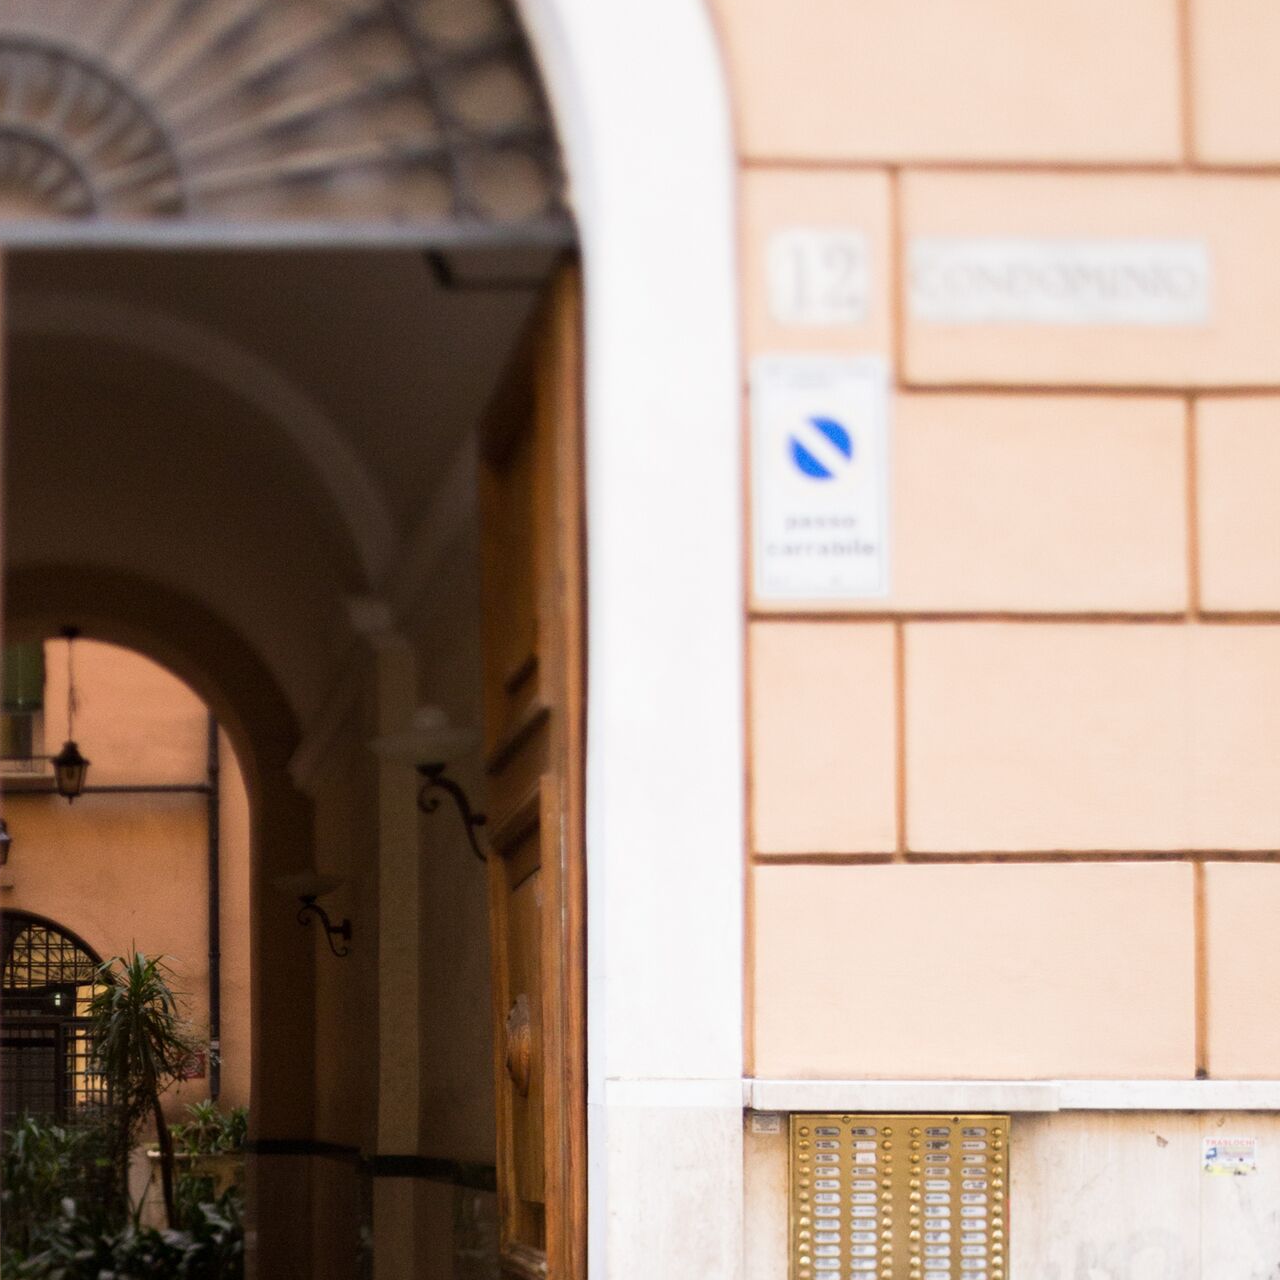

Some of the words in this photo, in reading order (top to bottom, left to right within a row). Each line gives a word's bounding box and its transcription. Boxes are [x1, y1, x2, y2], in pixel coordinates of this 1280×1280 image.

[788, 240, 862, 309] 12
[785, 515, 857, 532] passo
[766, 538, 875, 557] carrabile
[1205, 1138, 1255, 1146] TRASLOCHI
